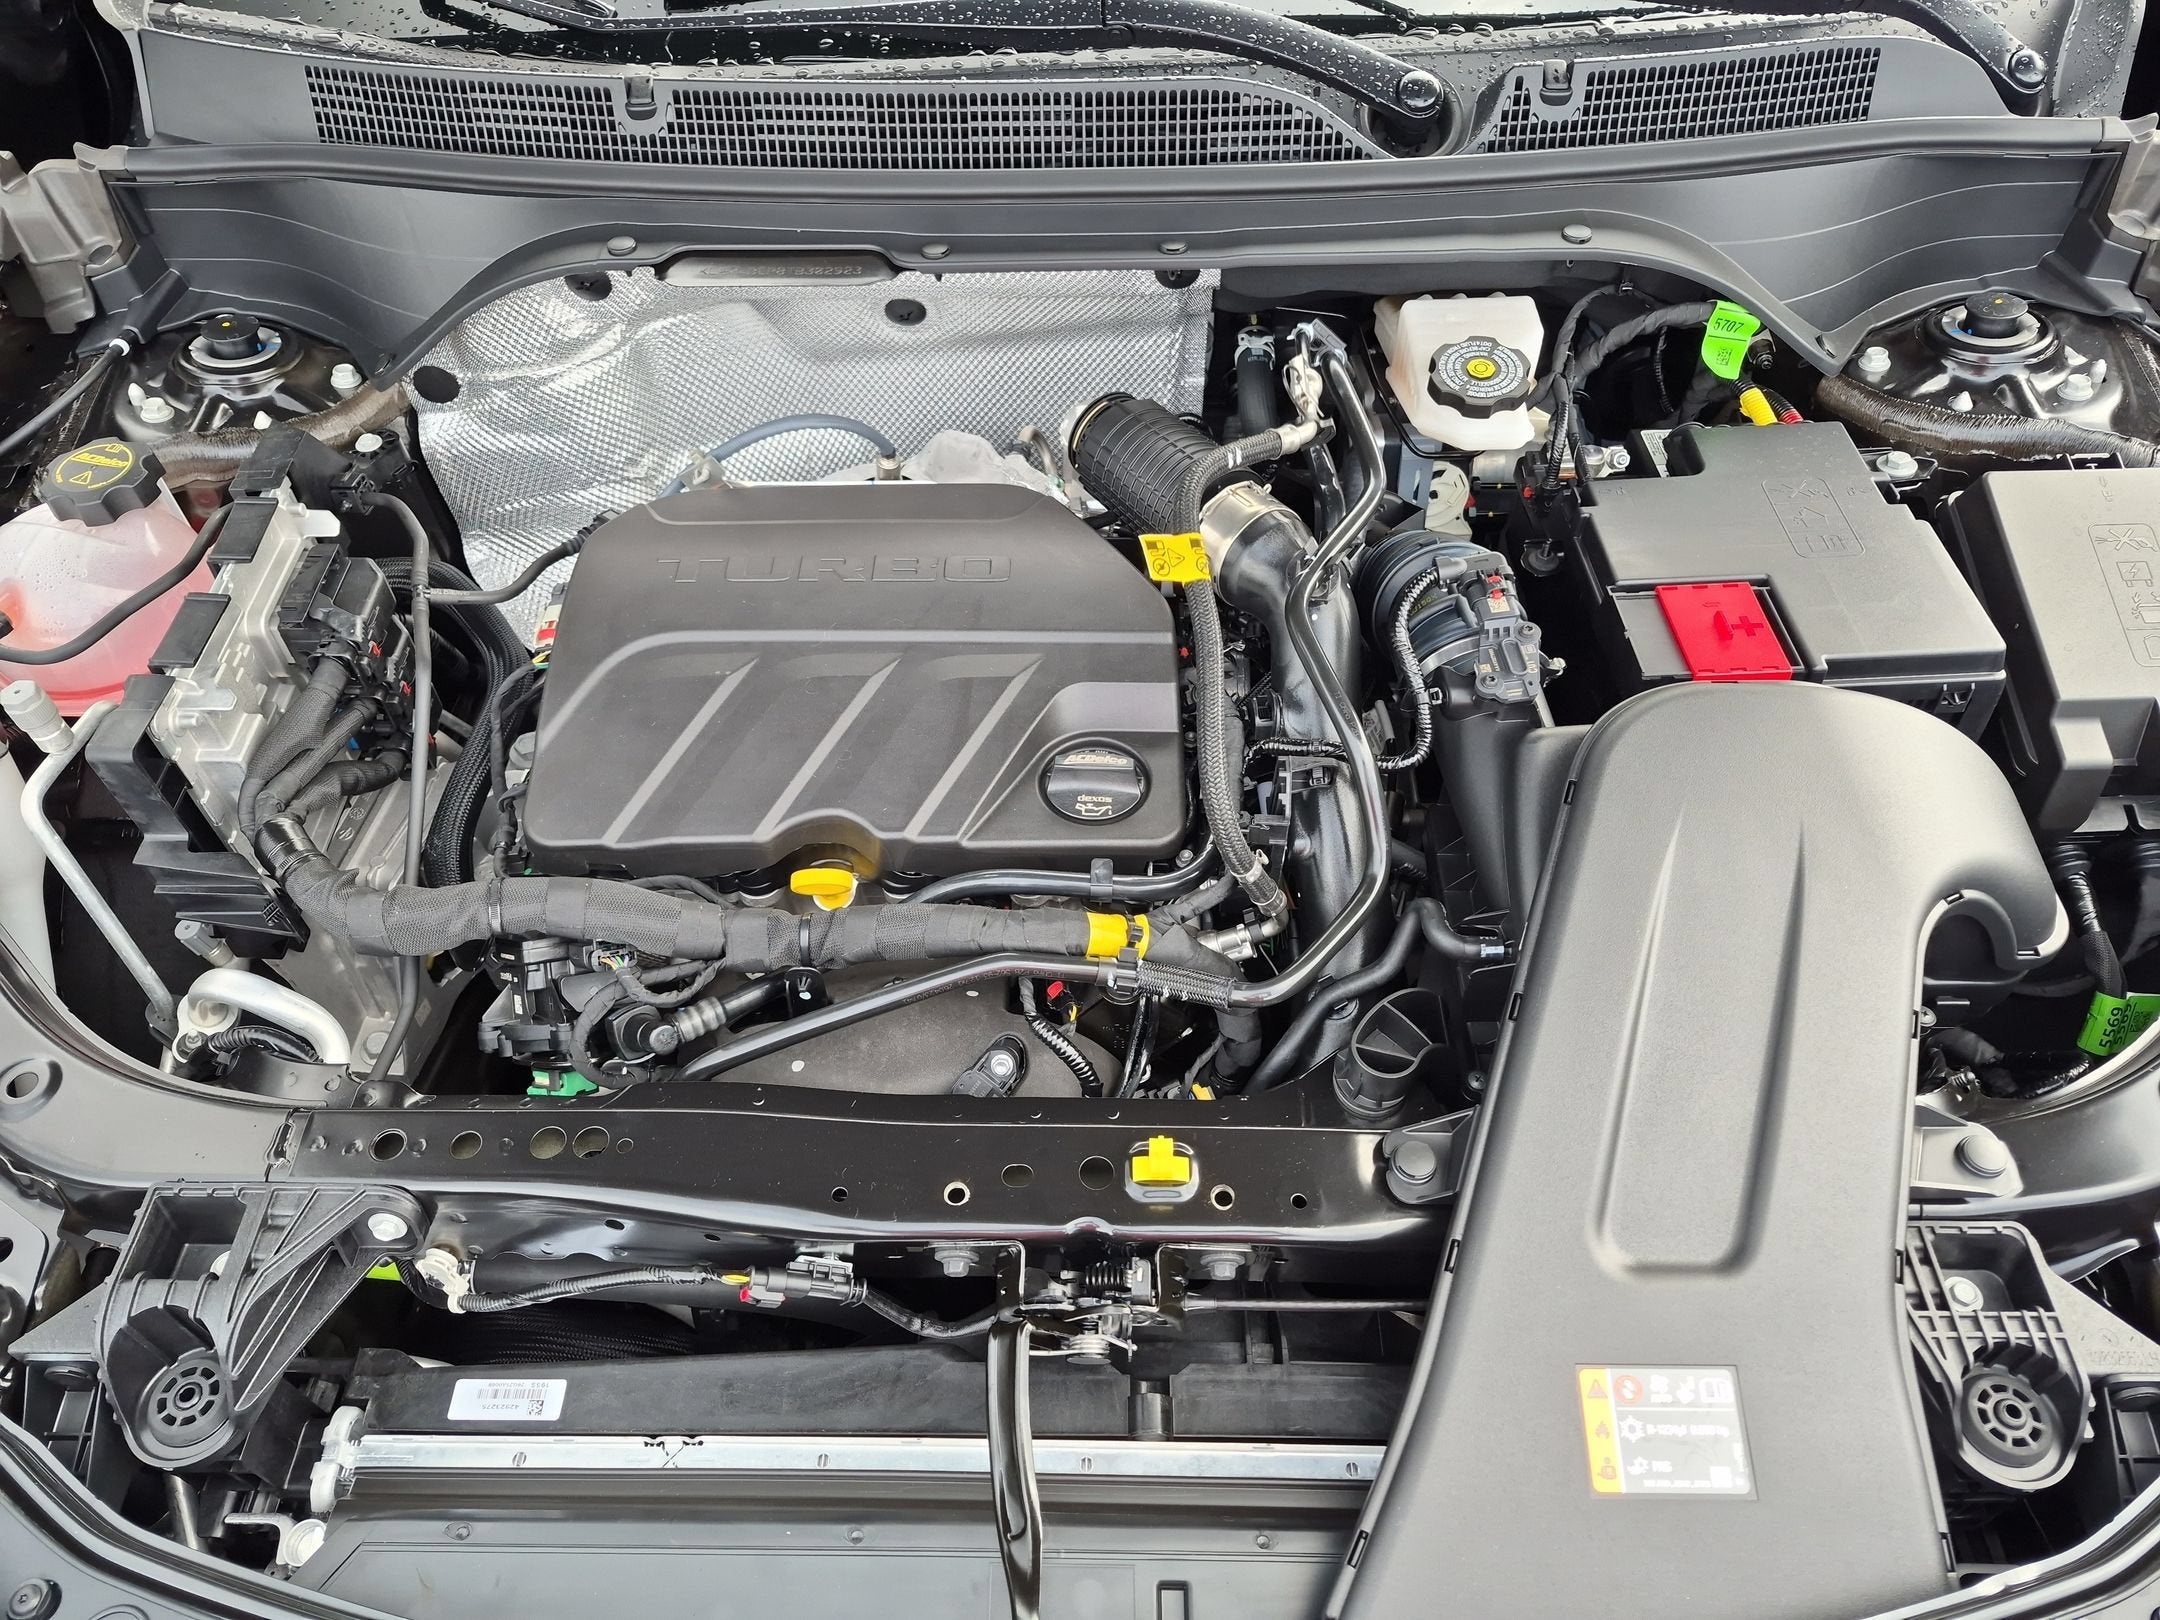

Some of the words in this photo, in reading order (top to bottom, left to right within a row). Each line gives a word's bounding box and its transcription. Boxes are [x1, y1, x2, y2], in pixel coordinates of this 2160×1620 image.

[1713, 318, 1745, 333] 5707
[657, 555, 1011, 583] TURBO
[1063, 754, 1128, 764] ACDelco
[1077, 794, 1113, 803] dexos
[2099, 1007, 2123, 1048] 5569
